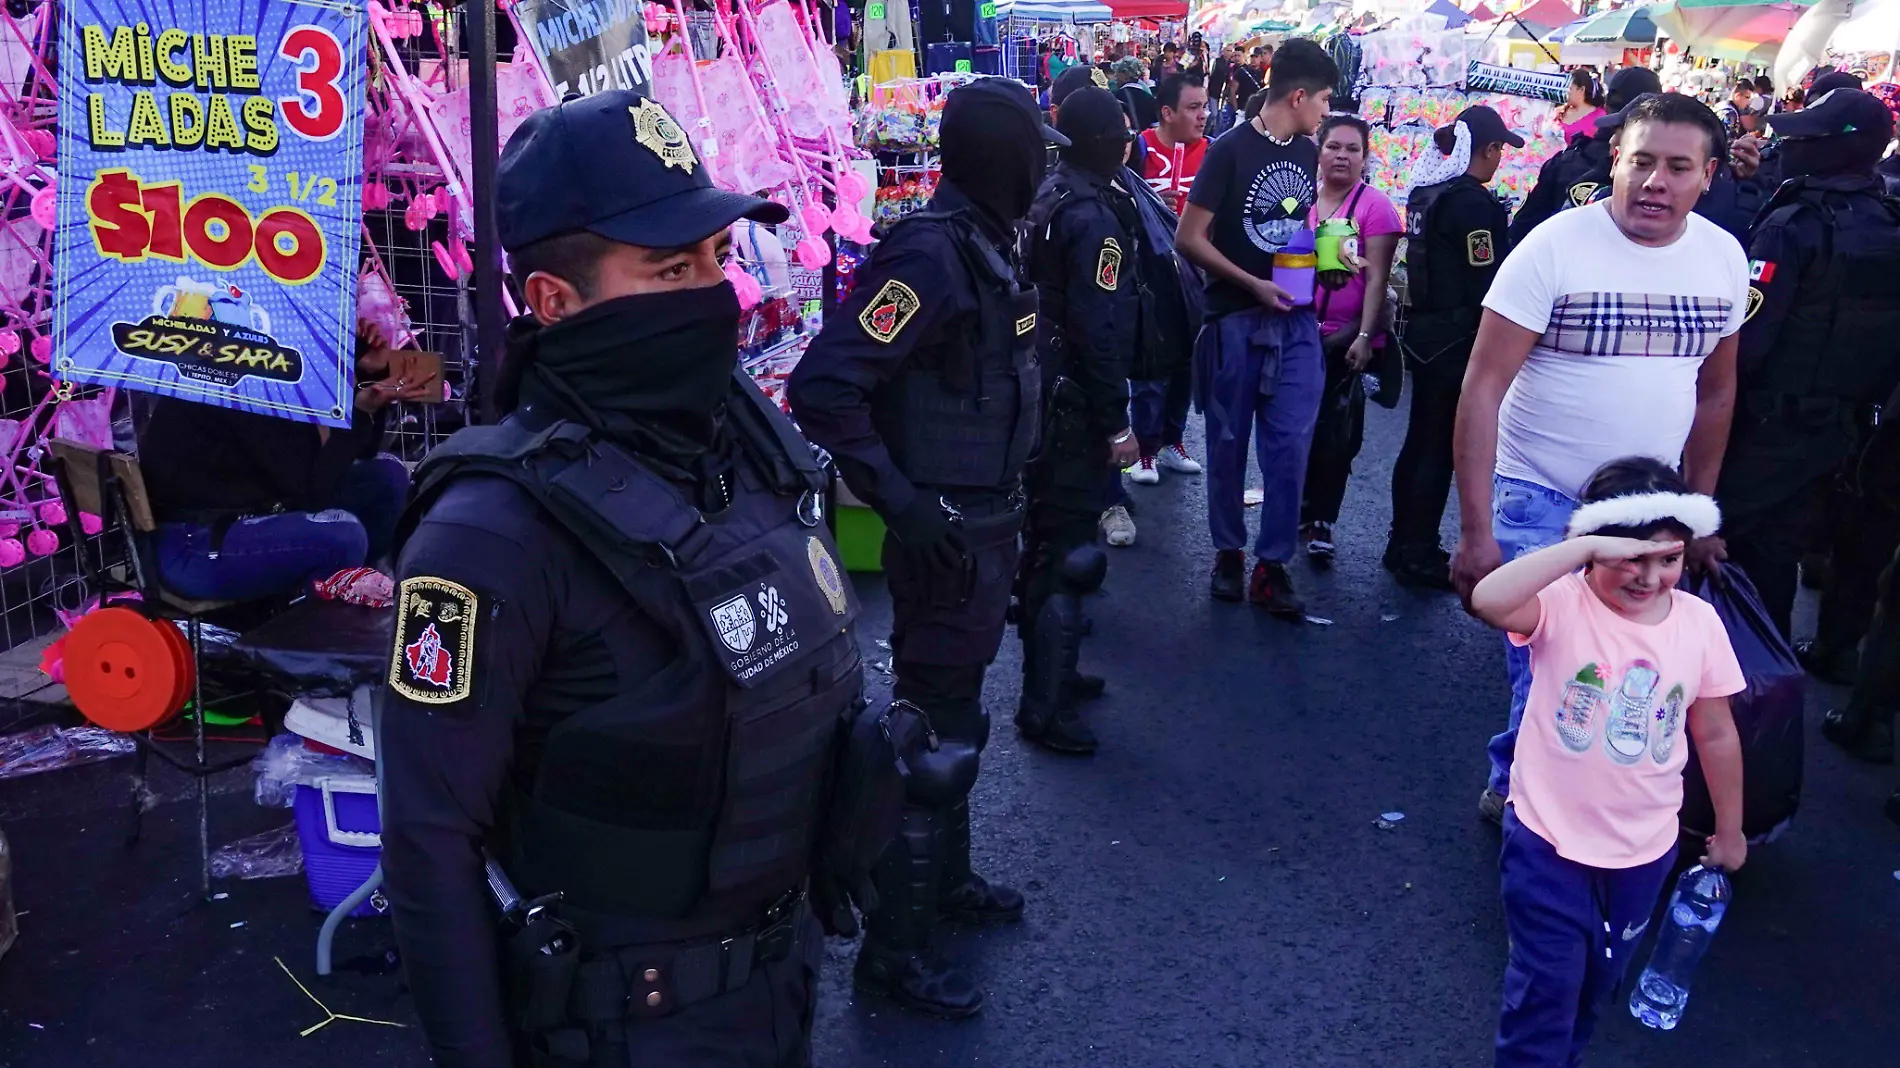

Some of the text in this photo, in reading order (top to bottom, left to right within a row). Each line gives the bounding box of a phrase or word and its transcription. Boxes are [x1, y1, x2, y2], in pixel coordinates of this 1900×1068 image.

[278, 24, 345, 141] 3
[87, 91, 279, 152] LADAS
[248, 164, 337, 206] 3 1/2
[1243, 169, 1268, 214] PARADISE
[1266, 160, 1308, 181] CALIFORNIA
[85, 167, 327, 286] $100
[123, 330, 293, 372] SUSY & SARA
[152, 318, 269, 344] MICHELADAS Y AZULES
[179, 362, 207, 374] CHICAS
[207, 367, 229, 378] DOBLE
[730, 629, 796, 671] GOBIERNO DE LA
[764, 656, 775, 668] DE
